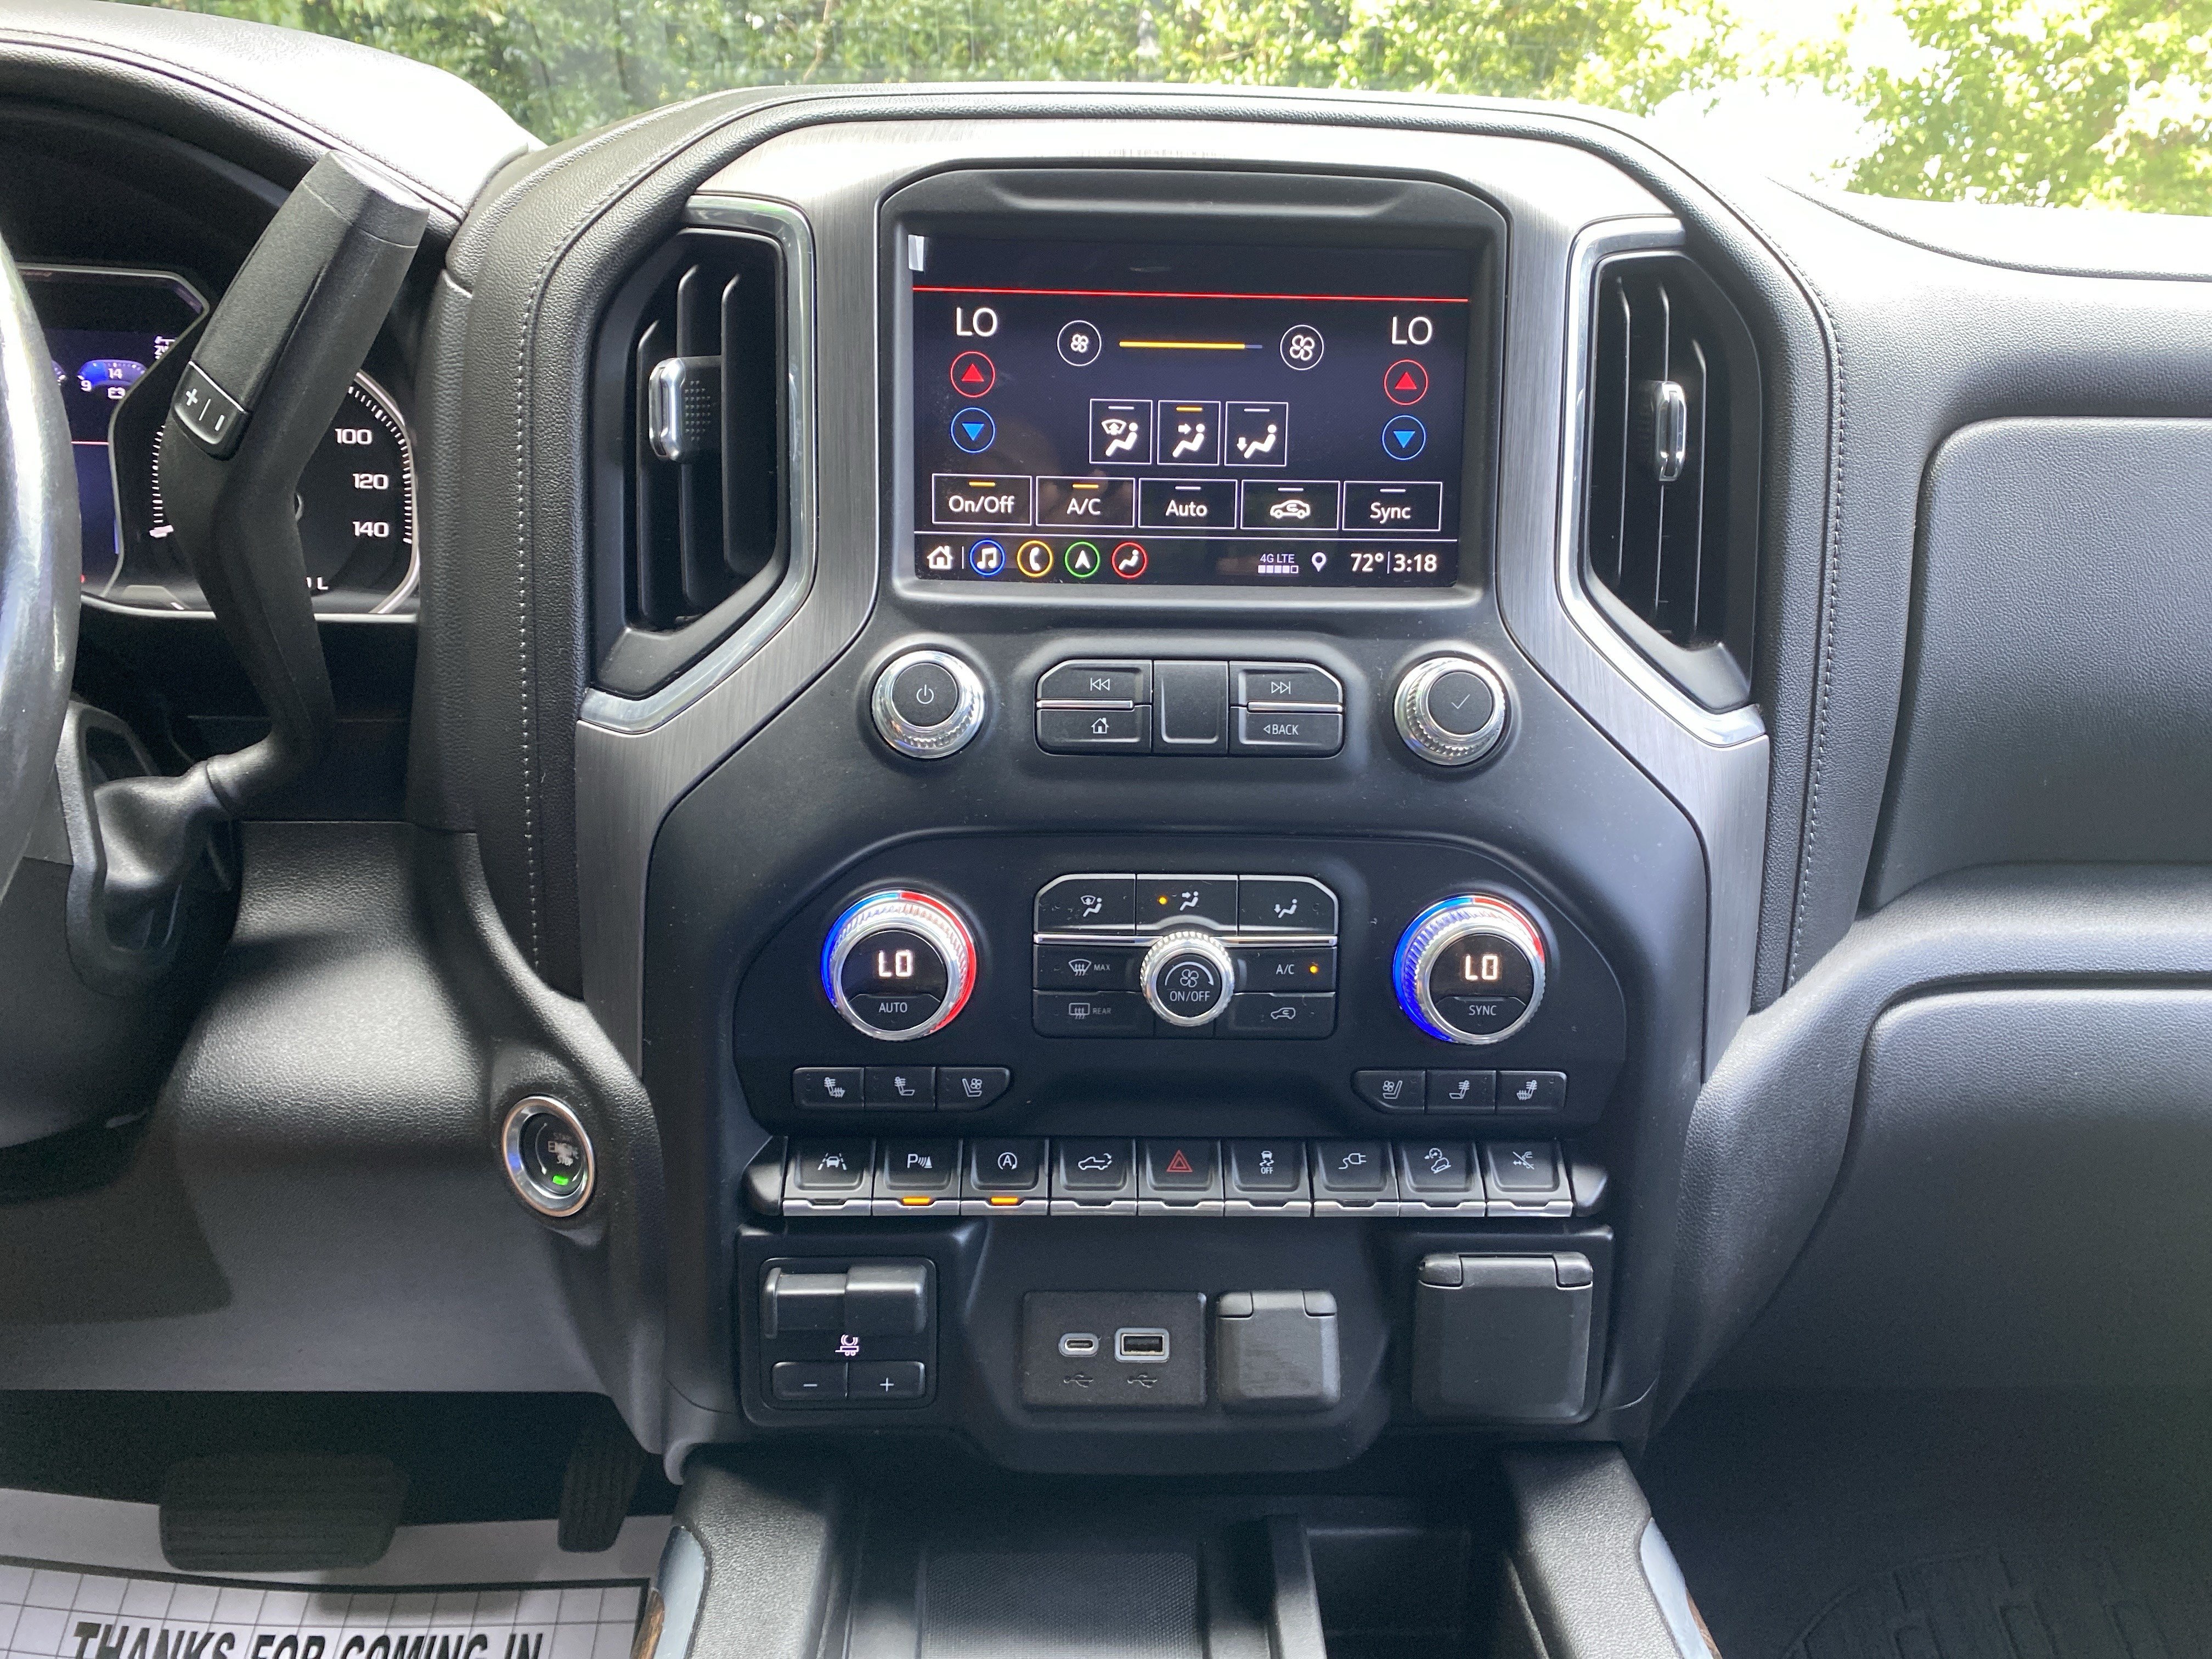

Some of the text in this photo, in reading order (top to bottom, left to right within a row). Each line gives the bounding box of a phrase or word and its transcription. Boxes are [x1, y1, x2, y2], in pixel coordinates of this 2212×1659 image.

[956, 307, 998, 337] LO
[1391, 316, 1434, 345] LO
[108, 368, 123, 380] 14
[81, 380, 92, 392] 9
[335, 428, 373, 445] 100
[352, 473, 389, 490] 120
[948, 495, 1015, 514] On/Off
[1066, 498, 1101, 515] A/C
[1165, 500, 1208, 517] Auto
[1369, 502, 1412, 524] Sync
[352, 521, 390, 538] 140
[1260, 554, 1295, 564] 4G LTE
[1392, 553, 1437, 572] 3:18
[1272, 724, 1299, 736] BACK
[878, 950, 913, 978] LO
[1276, 963, 1295, 975] A/C
[1464, 953, 1498, 981] LO
[1169, 990, 1211, 1002] ON/OFF
[878, 1002, 908, 1013] AUTO
[1468, 1005, 1497, 1016] SYNC
